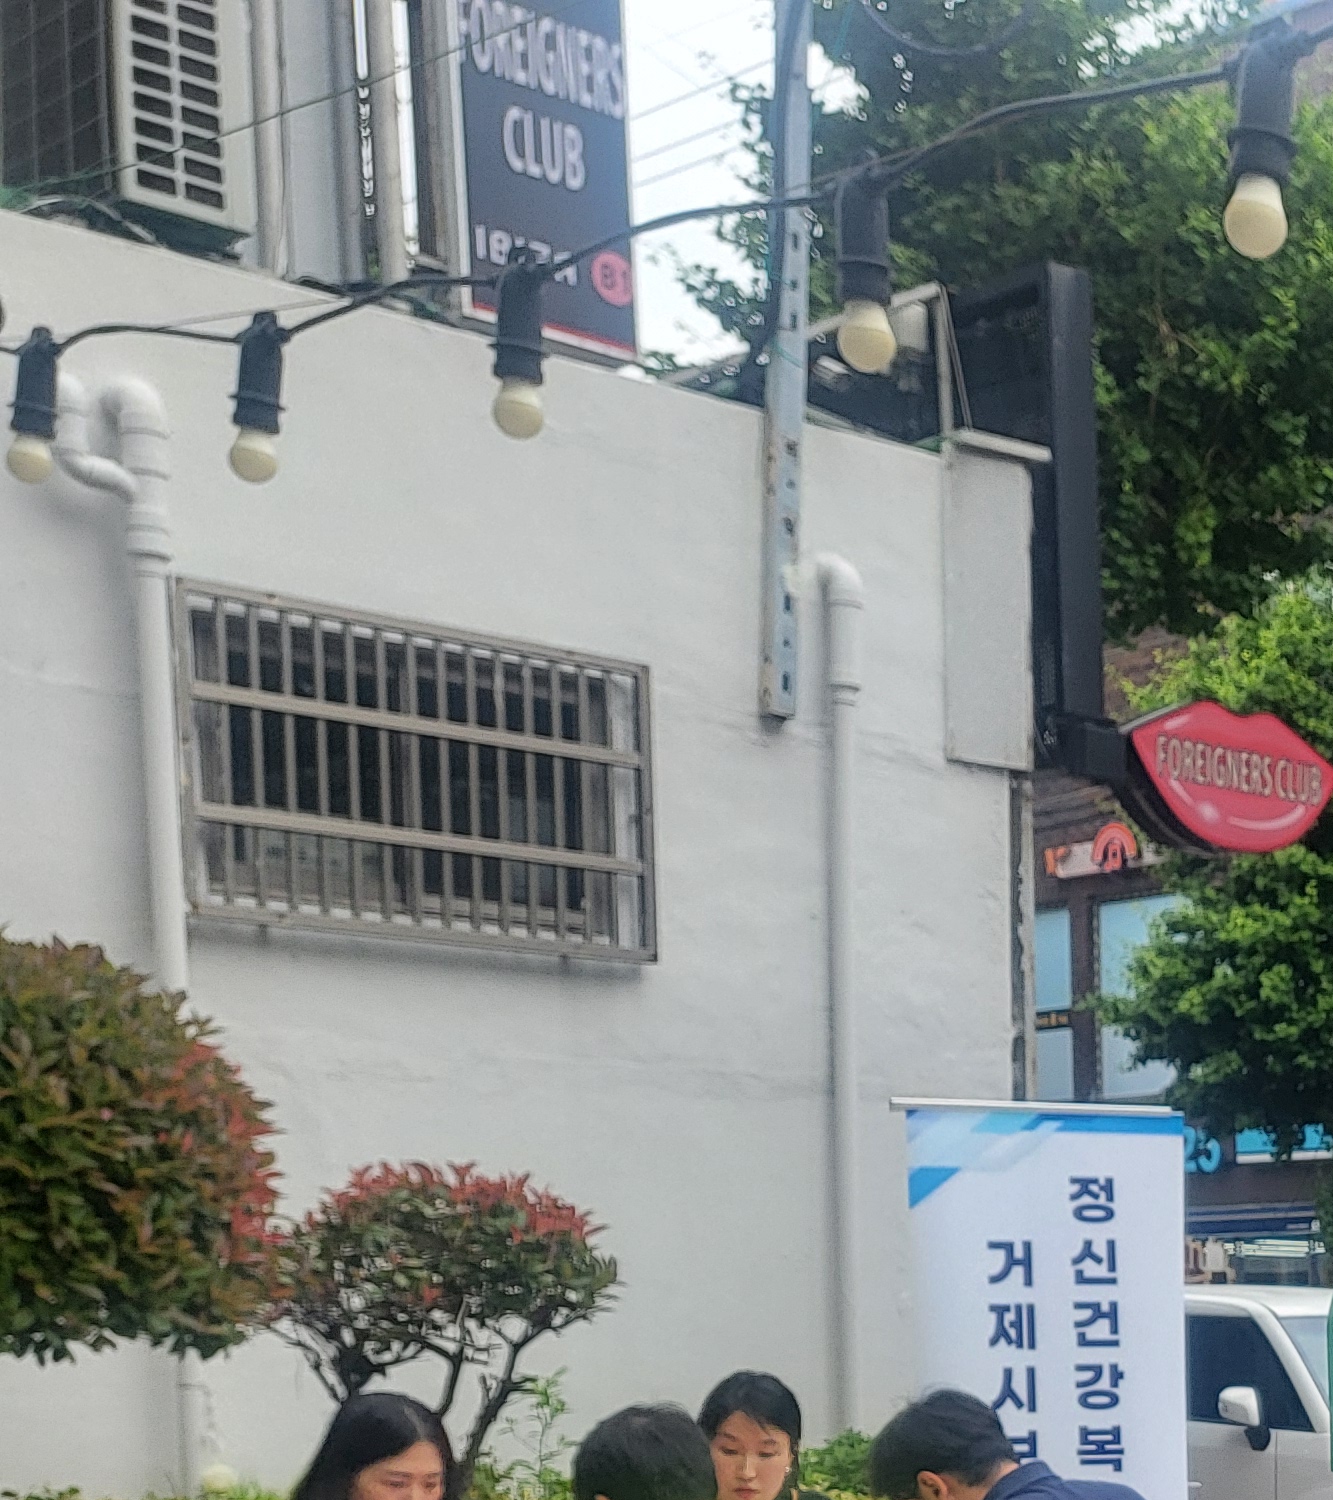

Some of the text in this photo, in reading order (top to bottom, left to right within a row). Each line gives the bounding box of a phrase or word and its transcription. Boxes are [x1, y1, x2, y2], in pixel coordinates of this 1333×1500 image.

[459, 0, 625, 120] FOREIGNERS
[503, 105, 586, 192] CLUB
[1156, 733, 1323, 807] FOREIGNERS CLUB
[1066, 1175, 1126, 1473] 정신건강복
